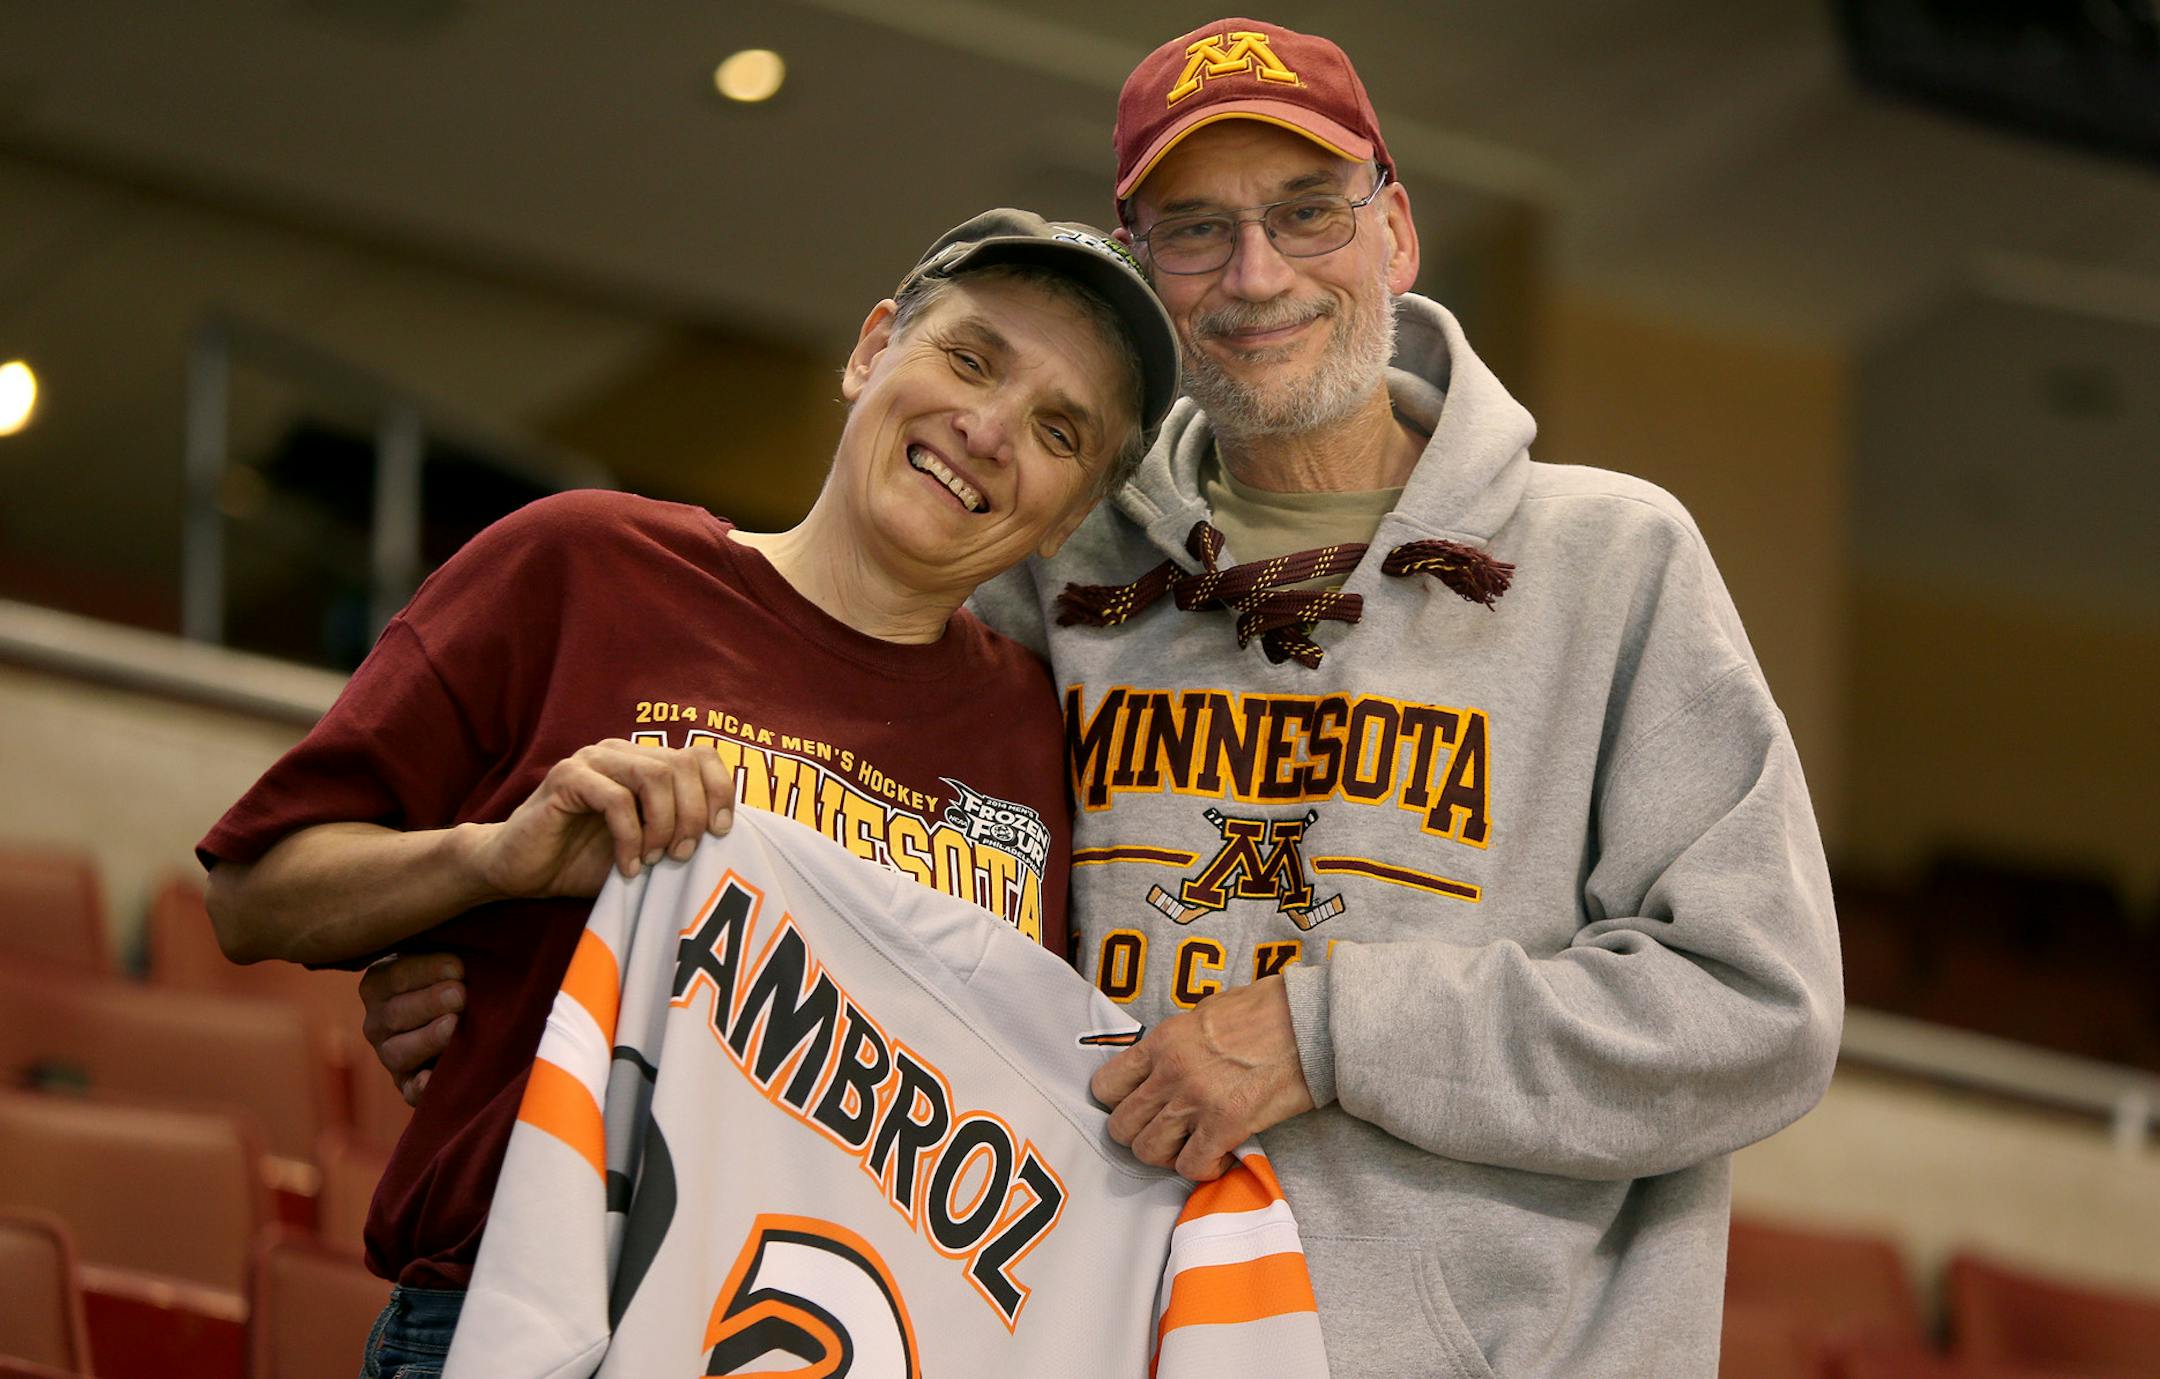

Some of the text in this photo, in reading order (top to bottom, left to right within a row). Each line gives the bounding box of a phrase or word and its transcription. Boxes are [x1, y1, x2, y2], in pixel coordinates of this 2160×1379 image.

[1167, 31, 1299, 109] M
[636, 701, 939, 814] 2014 NCAA MEN'S HOCKEY
[1064, 684, 1492, 849] MINNESOTA
[632, 730, 1044, 947] NNESOTA
[961, 789, 1049, 850] FROZEN
[967, 812, 1045, 868] FOUR
[986, 799, 1034, 818] 2014 MEN'S
[982, 837, 1041, 876] PHILADELPHIA
[1182, 817, 1314, 910] M
[668, 867, 1069, 1336] AMBROZ
